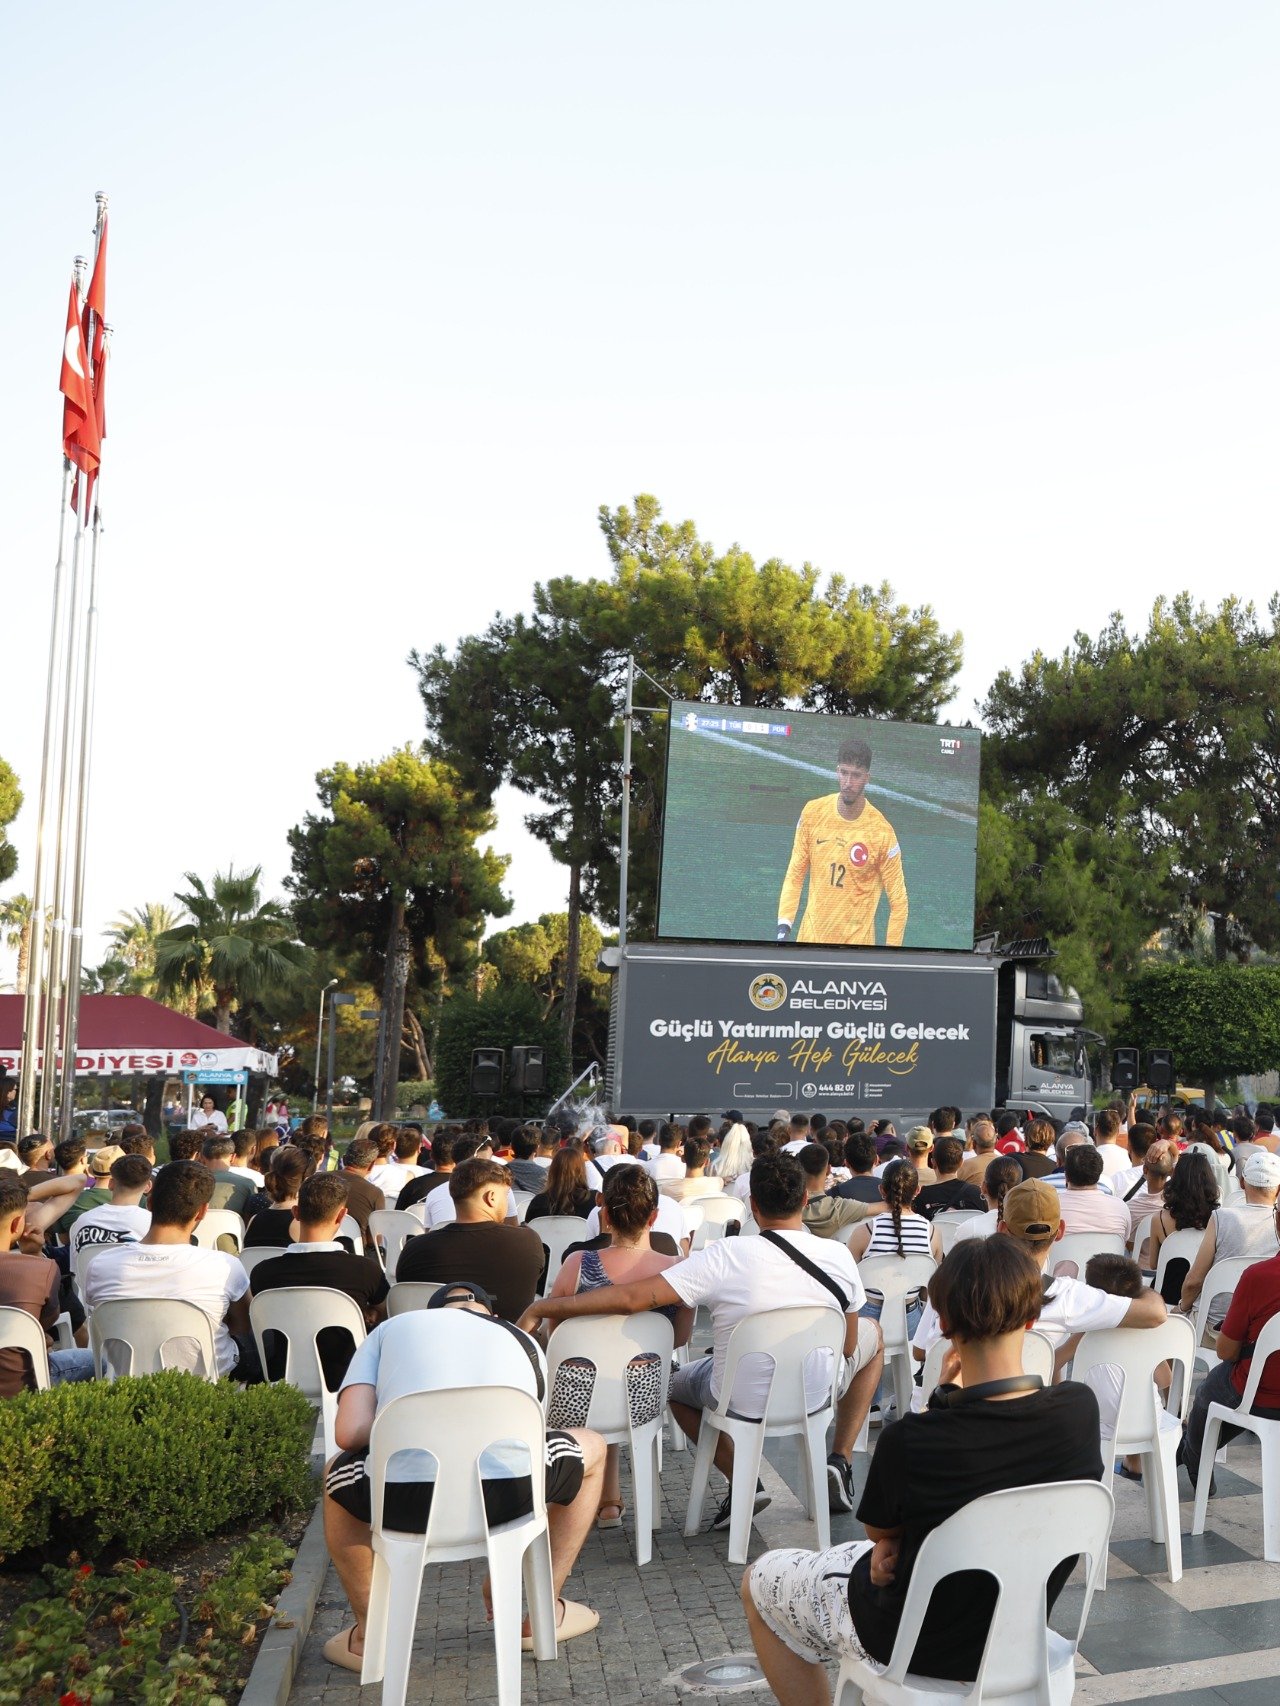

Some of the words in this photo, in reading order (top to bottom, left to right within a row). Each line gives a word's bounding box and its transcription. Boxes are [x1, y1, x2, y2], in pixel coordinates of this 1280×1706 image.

[830, 862, 846, 889] 12
[790, 980, 888, 996] ALANYA
[789, 997, 888, 1011] BELEDİYESİ
[649, 1019, 713, 1042] Güçlü
[718, 1020, 823, 1040] Yatırımlar
[827, 1022, 886, 1044] Güçlü
[890, 1023, 970, 1041] Gelecek
[0, 1052, 174, 1071] BDİYESİ
[707, 1039, 780, 1075] Alanya
[788, 1039, 832, 1073] Hep
[842, 1039, 919, 1077] Gülecek
[818, 1083, 833, 1092] 444
[834, 1083, 844, 1092] 82
[845, 1083, 855, 1092] 07
[1040, 1082, 1074, 1090] ALANYA
